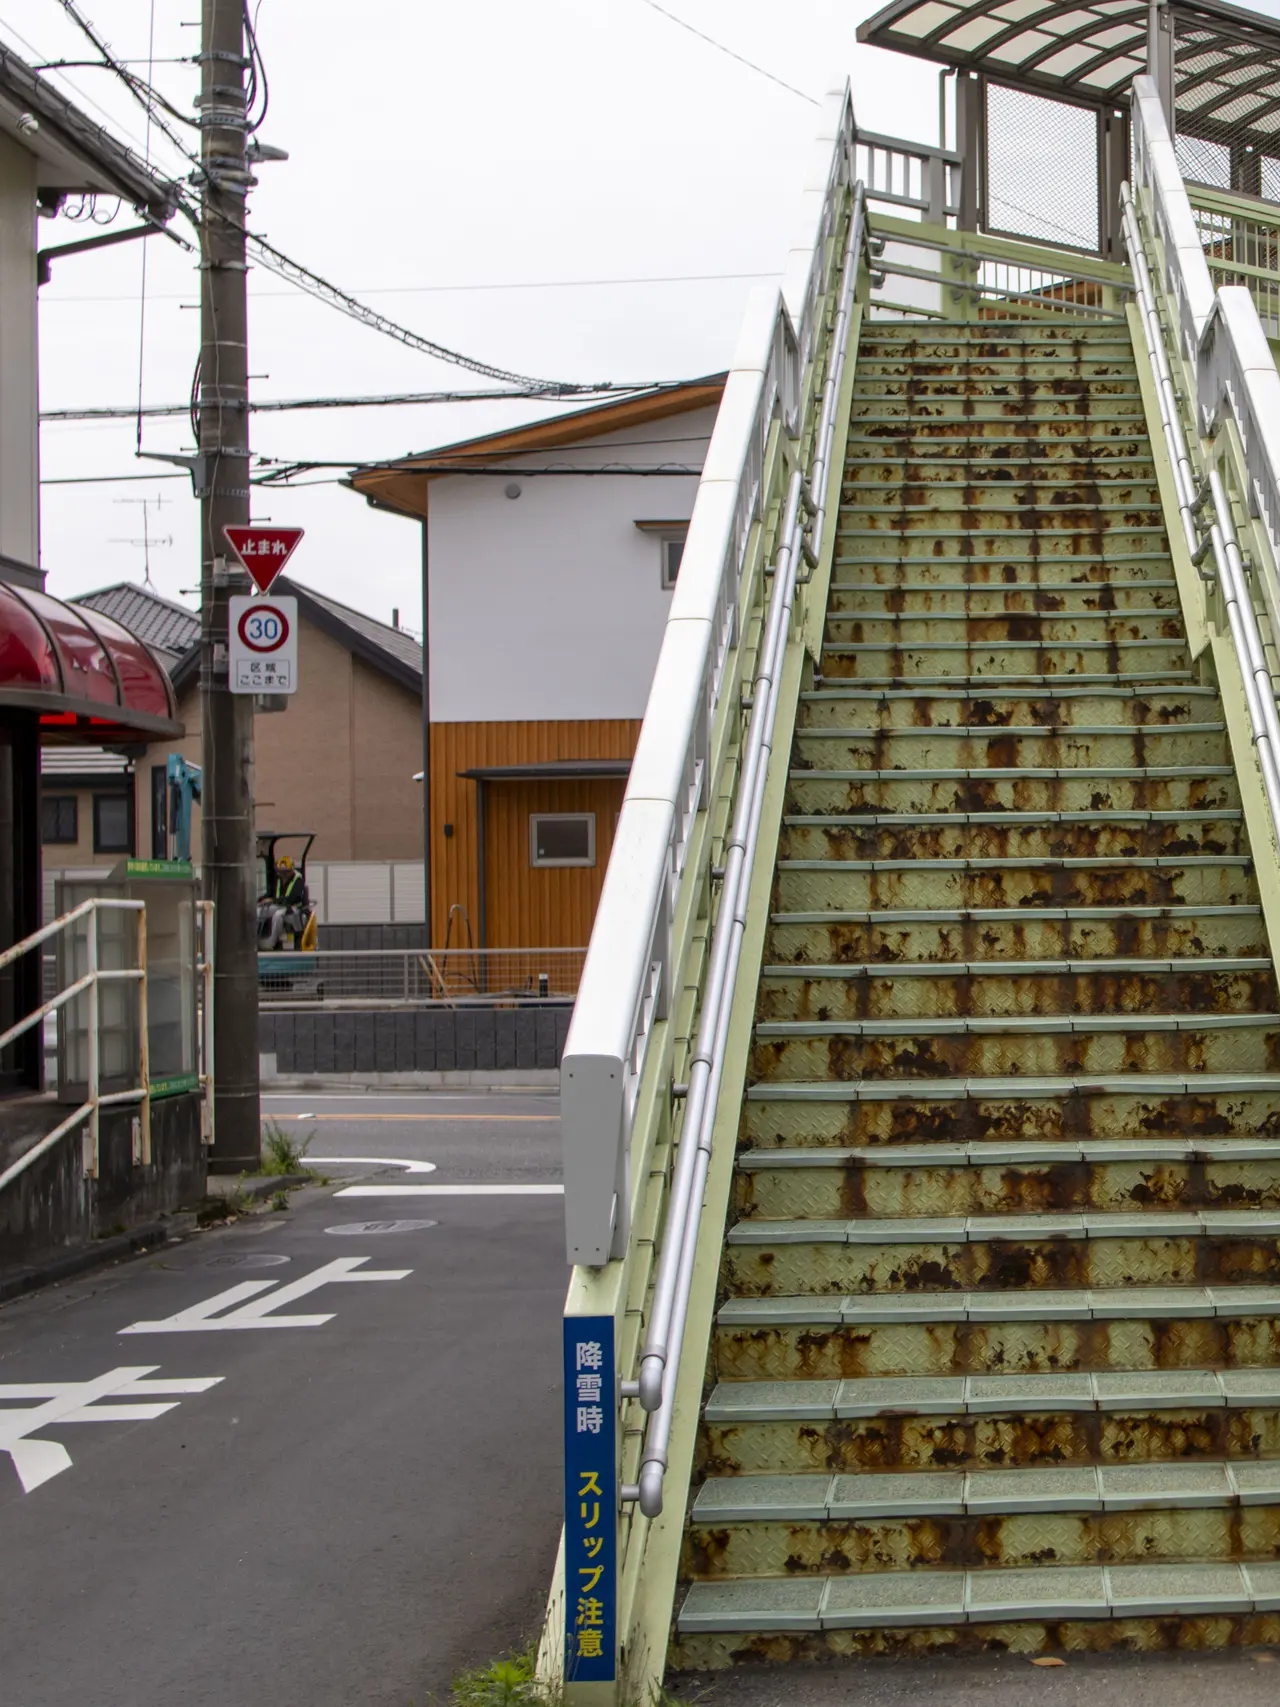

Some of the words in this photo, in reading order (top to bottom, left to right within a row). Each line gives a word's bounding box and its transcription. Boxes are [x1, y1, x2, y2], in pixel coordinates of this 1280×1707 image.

[240, 538, 288, 556] 止まれ
[249, 618, 278, 640] 30
[250, 662, 277, 673] 区域
[240, 674, 287, 686] ここまで
[575, 1341, 604, 1435] 降雪時
[576, 1470, 605, 1658] スリップ注意
